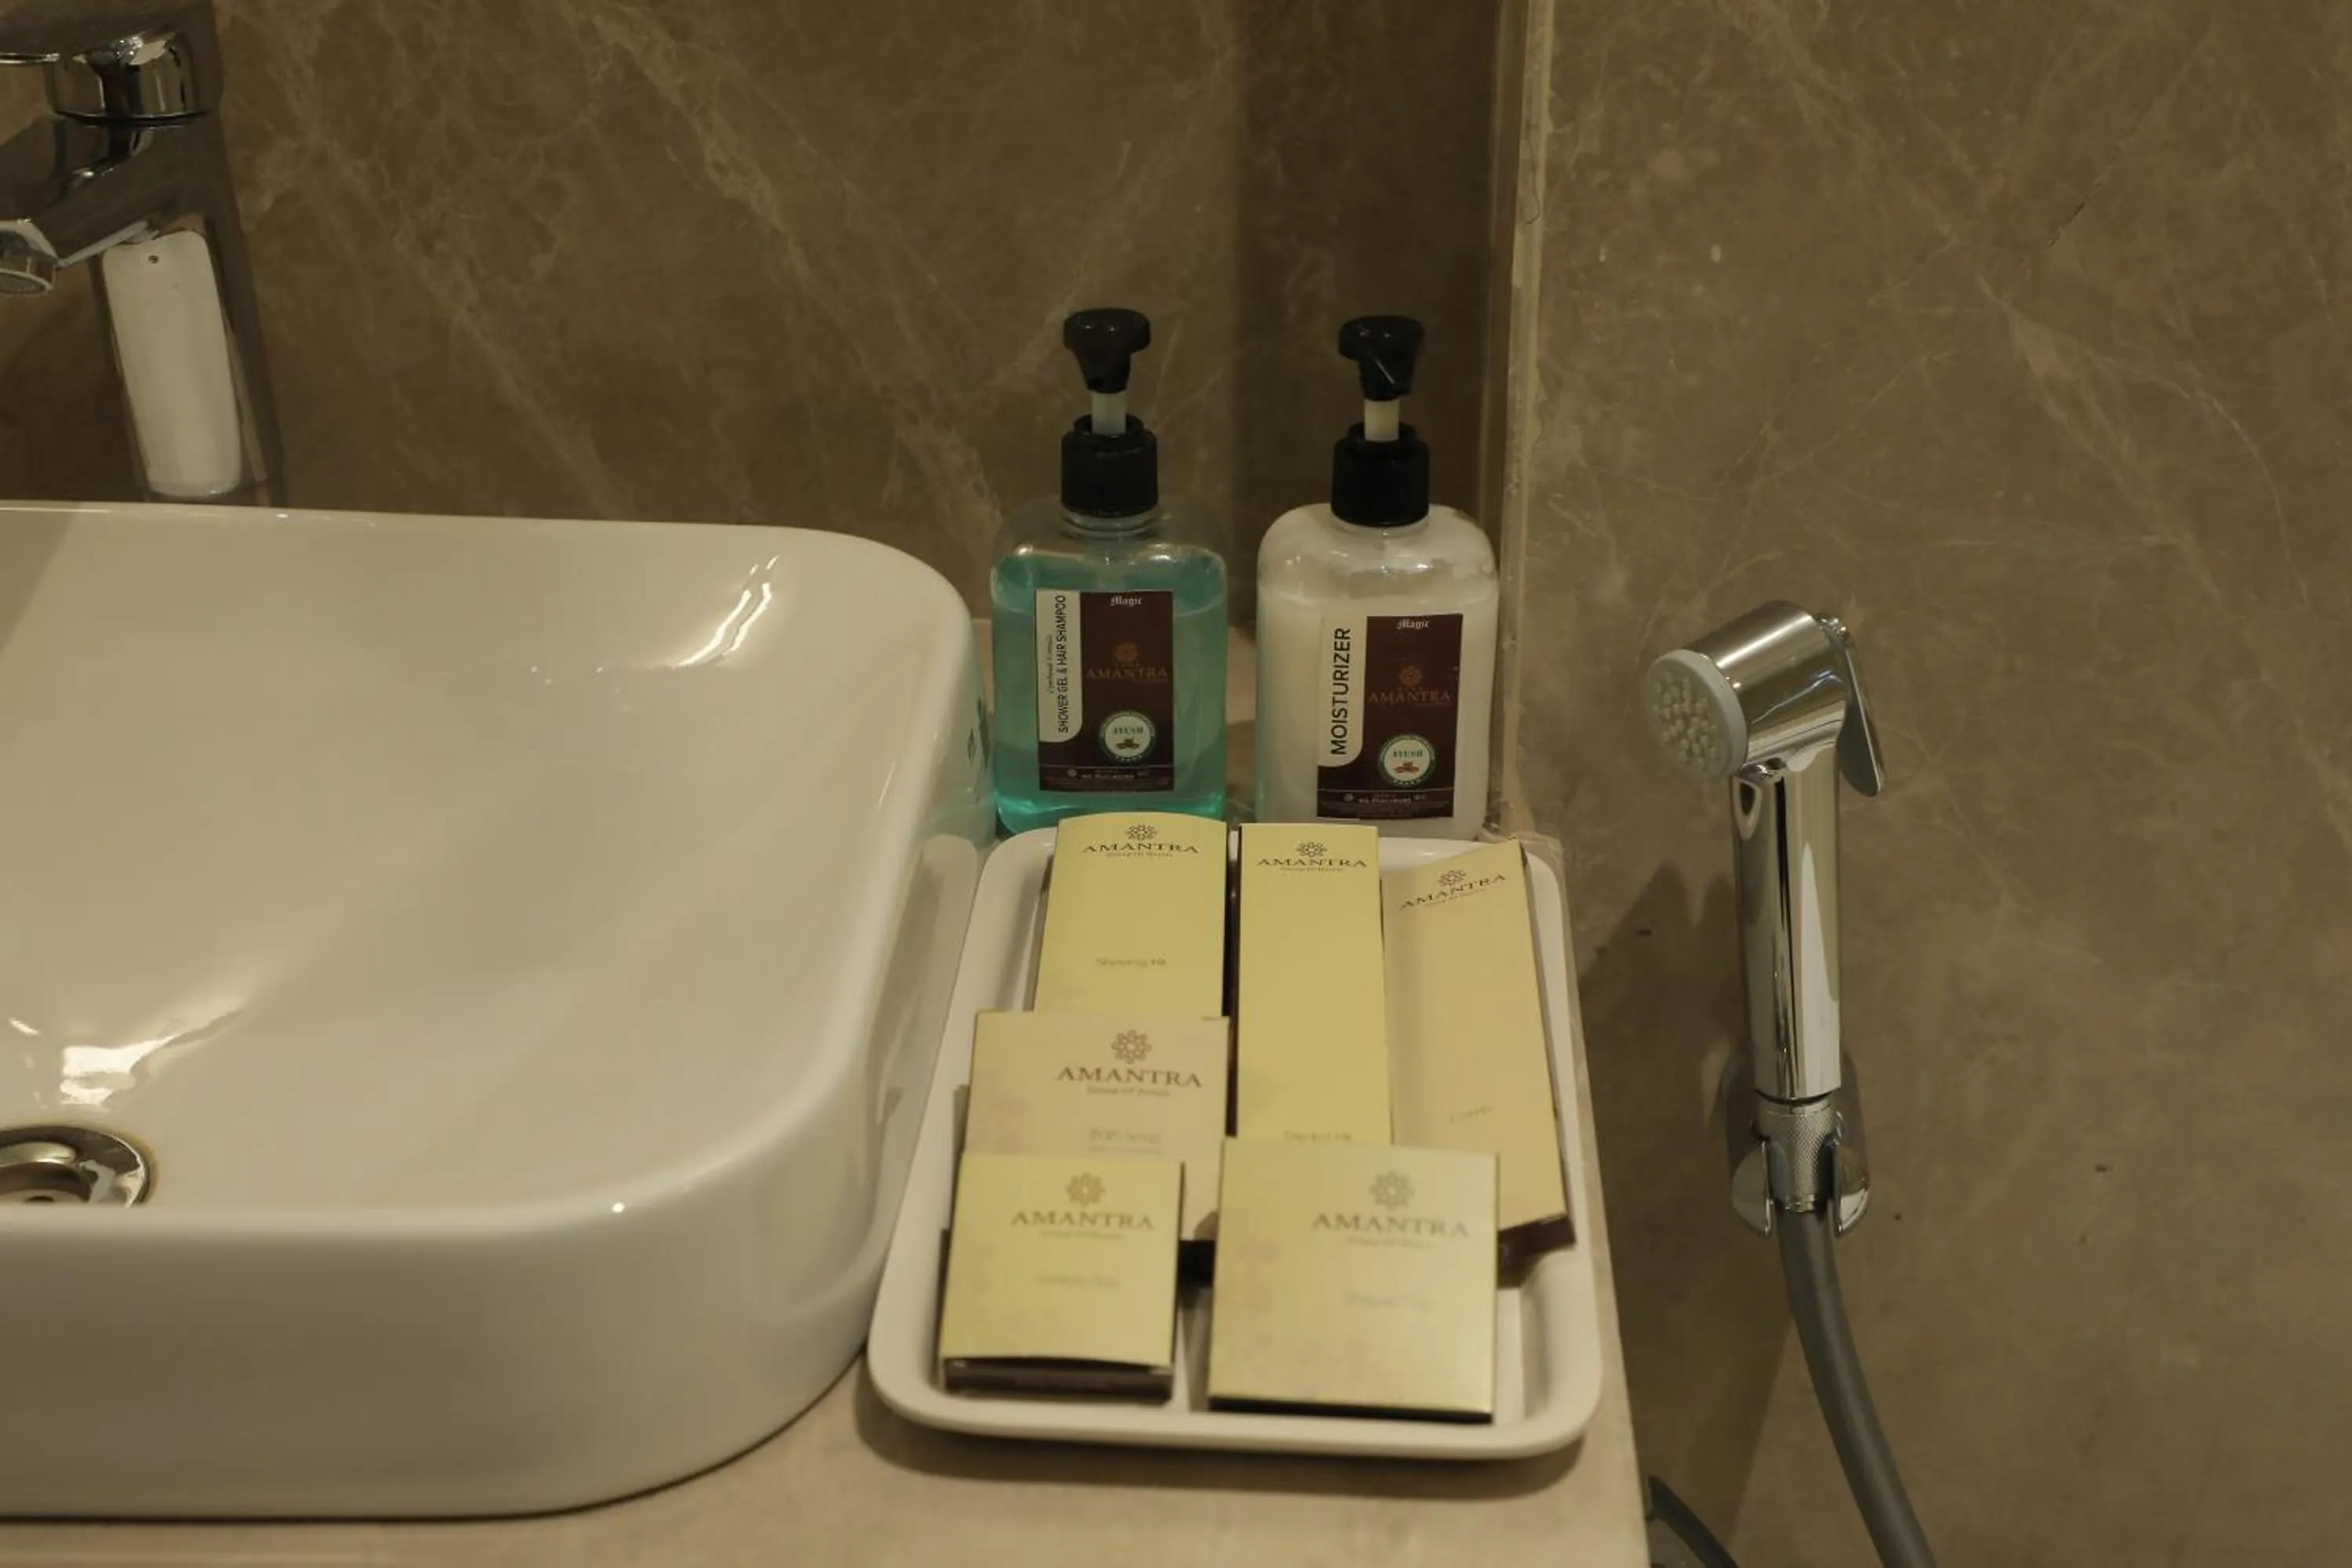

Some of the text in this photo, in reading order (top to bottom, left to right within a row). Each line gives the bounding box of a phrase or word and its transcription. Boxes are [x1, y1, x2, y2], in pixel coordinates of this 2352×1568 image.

[1054, 594, 1067, 642] SHAMPOO
[1056, 644, 1068, 666] HAIR
[1084, 666, 1168, 679] AMANTRA
[1330, 627, 1352, 756] MOISTURIZER
[1368, 689, 1451, 703] AMANTRA
[1057, 694, 1069, 734] SHOWER
[1081, 843, 1200, 854] AMANTRA
[1256, 858, 1367, 868] AMANTRA
[1399, 873, 1506, 910] AMANTRA
[1054, 1066, 1203, 1088] AMANTRA
[1010, 1210, 1155, 1230] AMANTRA
[1309, 1213, 1471, 1239] AMANTRA
